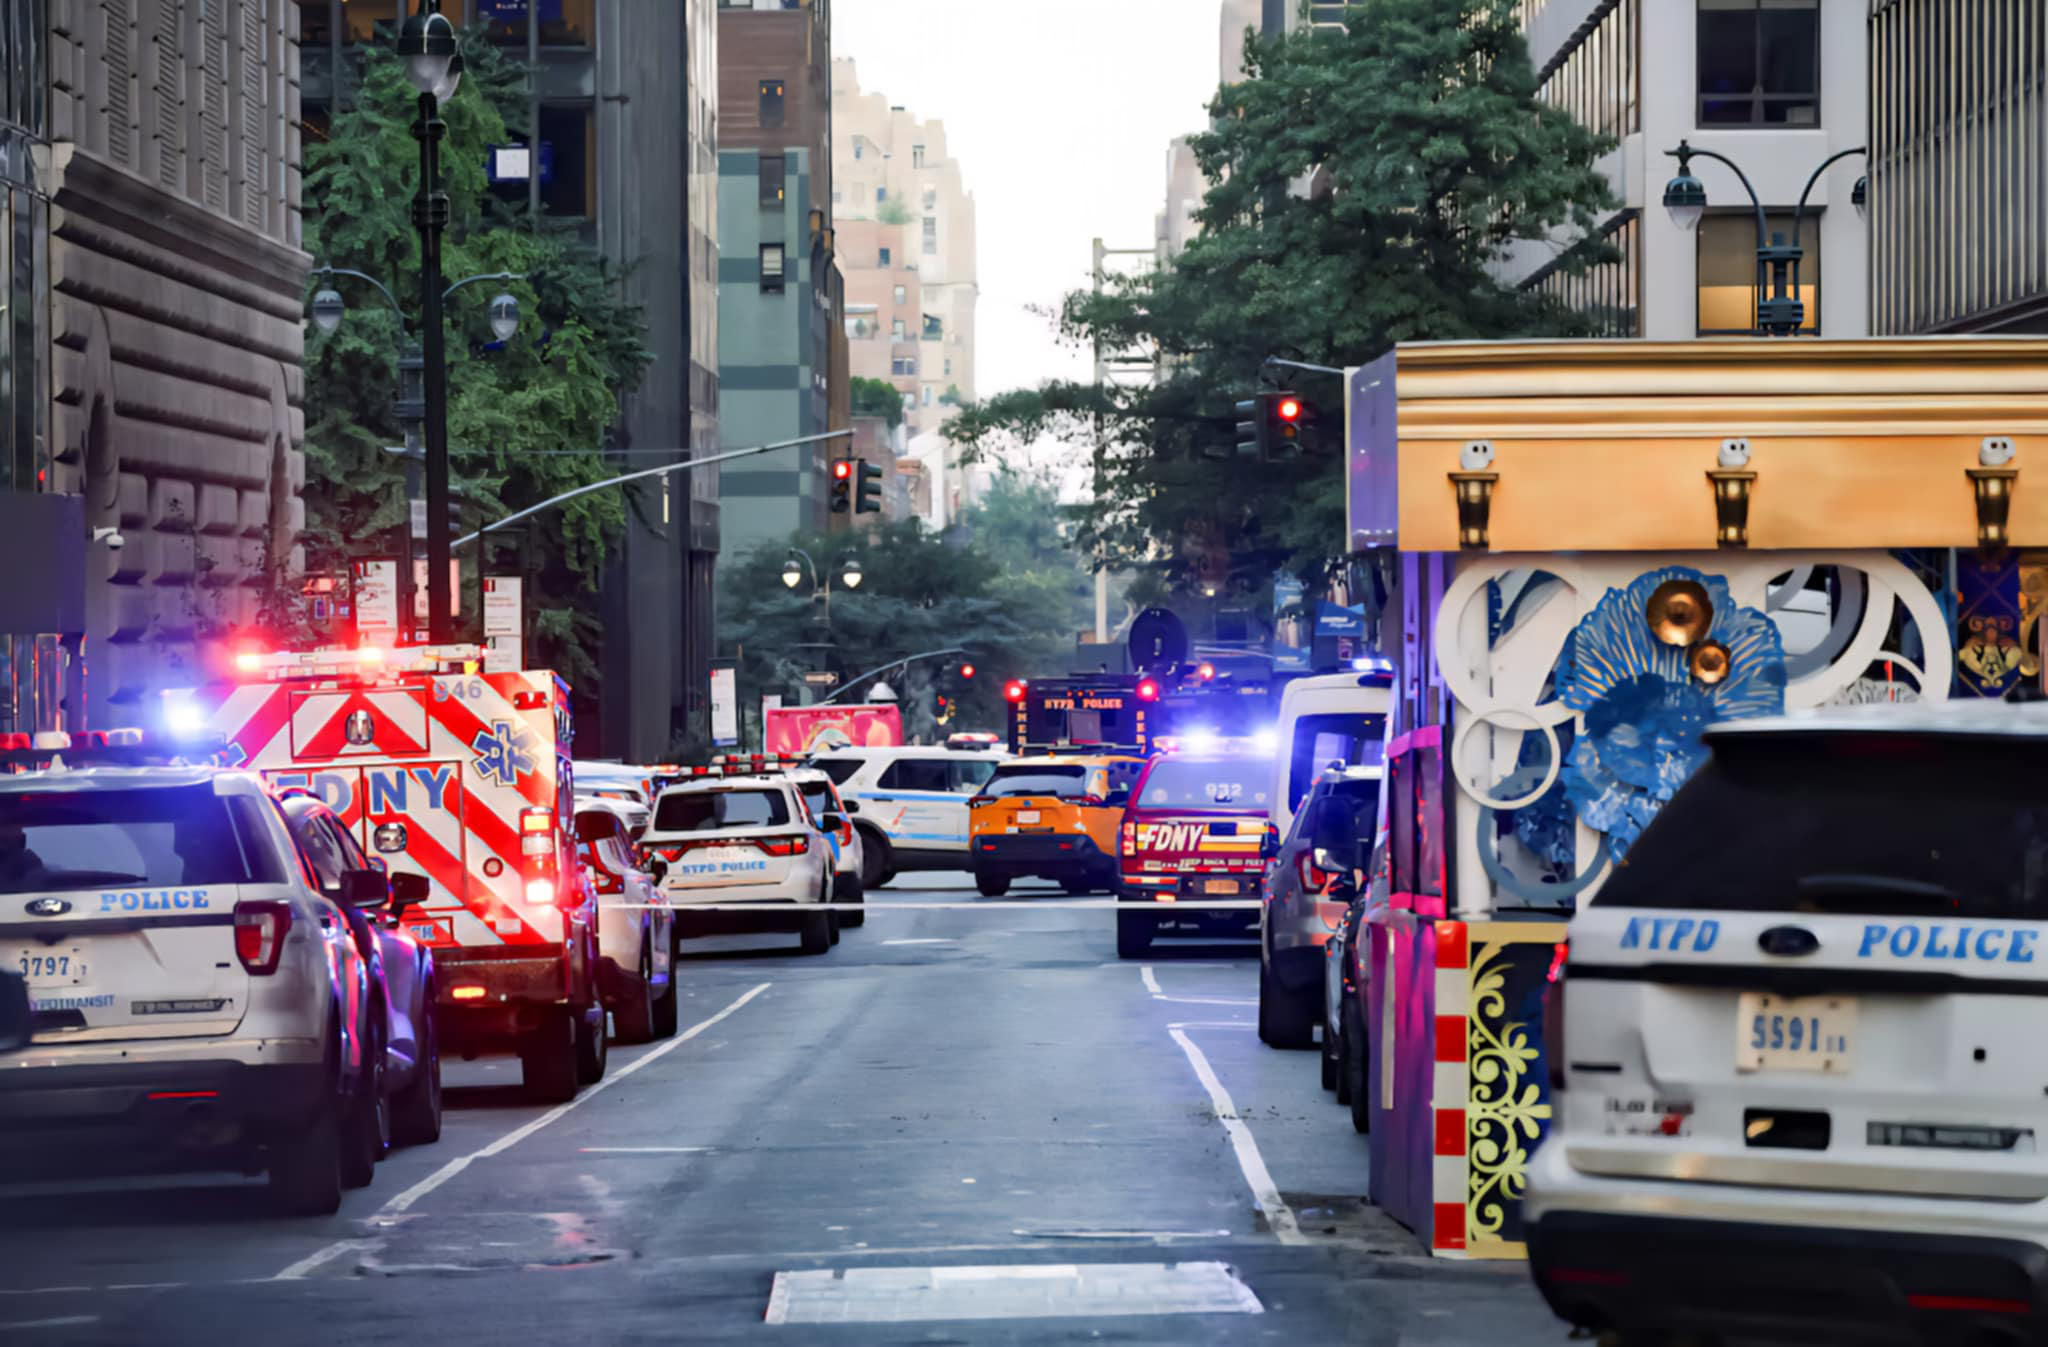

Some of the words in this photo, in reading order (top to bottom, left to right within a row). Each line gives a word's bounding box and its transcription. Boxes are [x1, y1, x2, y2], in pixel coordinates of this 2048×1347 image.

[433, 679, 482, 702] 946
[1082, 698, 1122, 709] POLICE
[1143, 824, 1204, 851] FDNY
[682, 863, 716, 874] NYPD
[721, 861, 766, 872] POLICE
[100, 890, 209, 912] POLICE
[1620, 917, 1720, 952] NYPD
[1856, 924, 2038, 963] POLICE
[19, 956, 69, 977] 3797
[1751, 1014, 1819, 1052] 5591
